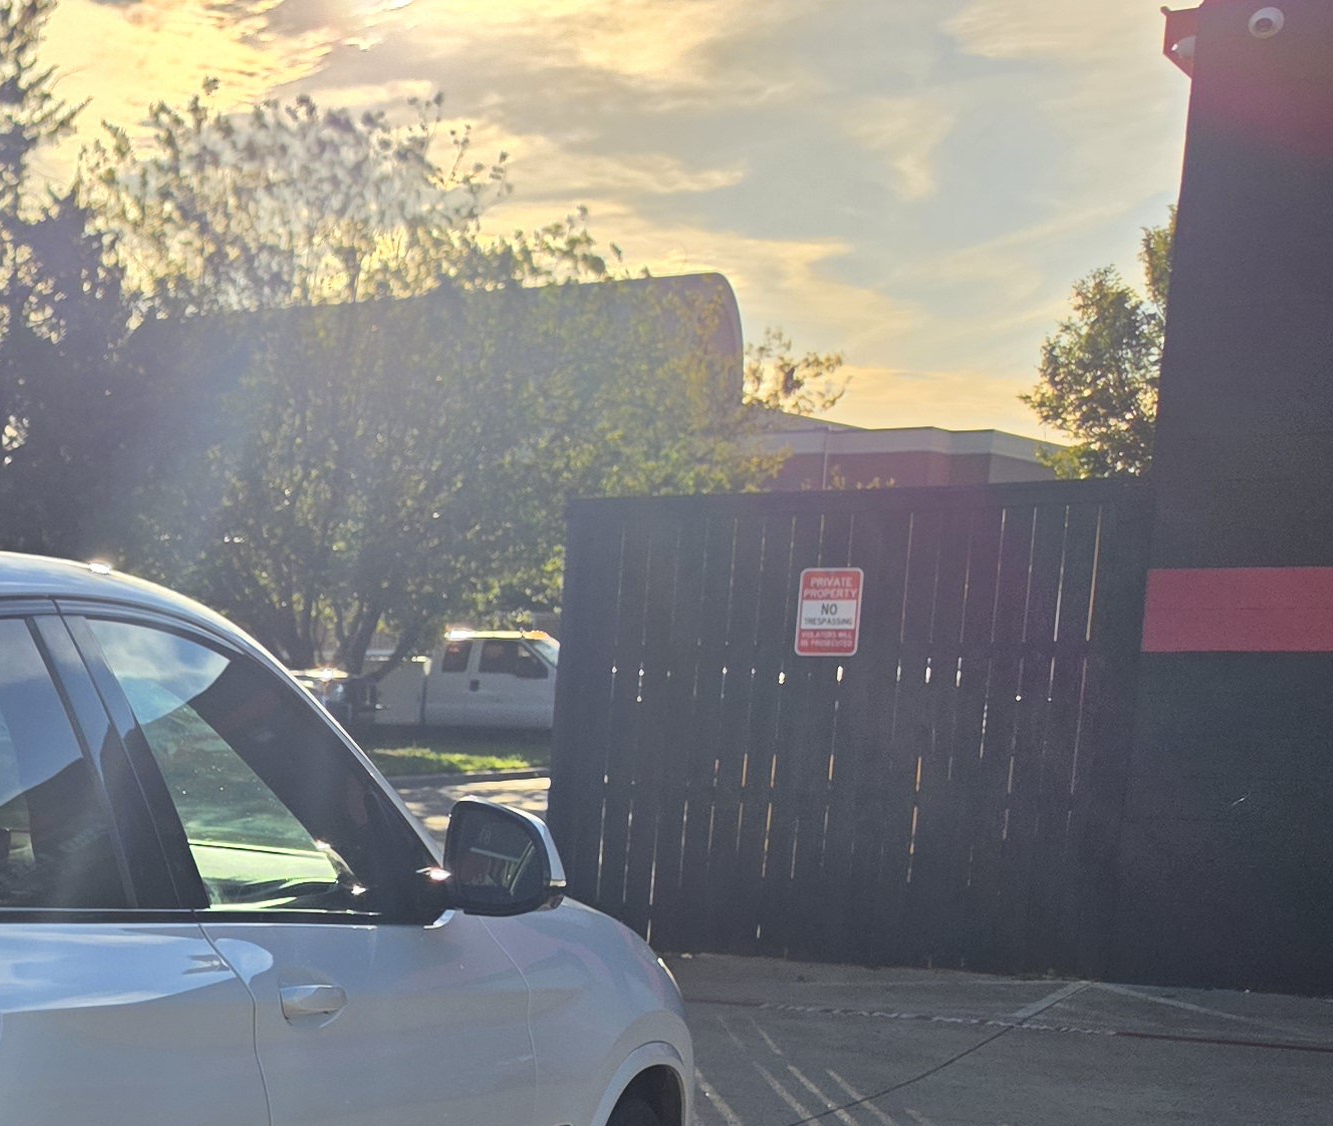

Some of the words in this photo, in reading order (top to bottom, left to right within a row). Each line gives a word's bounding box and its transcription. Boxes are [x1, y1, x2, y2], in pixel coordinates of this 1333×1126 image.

[810, 577, 853, 587] PRIVATE
[803, 588, 858, 599] PROPERTY
[820, 603, 838, 616] NO
